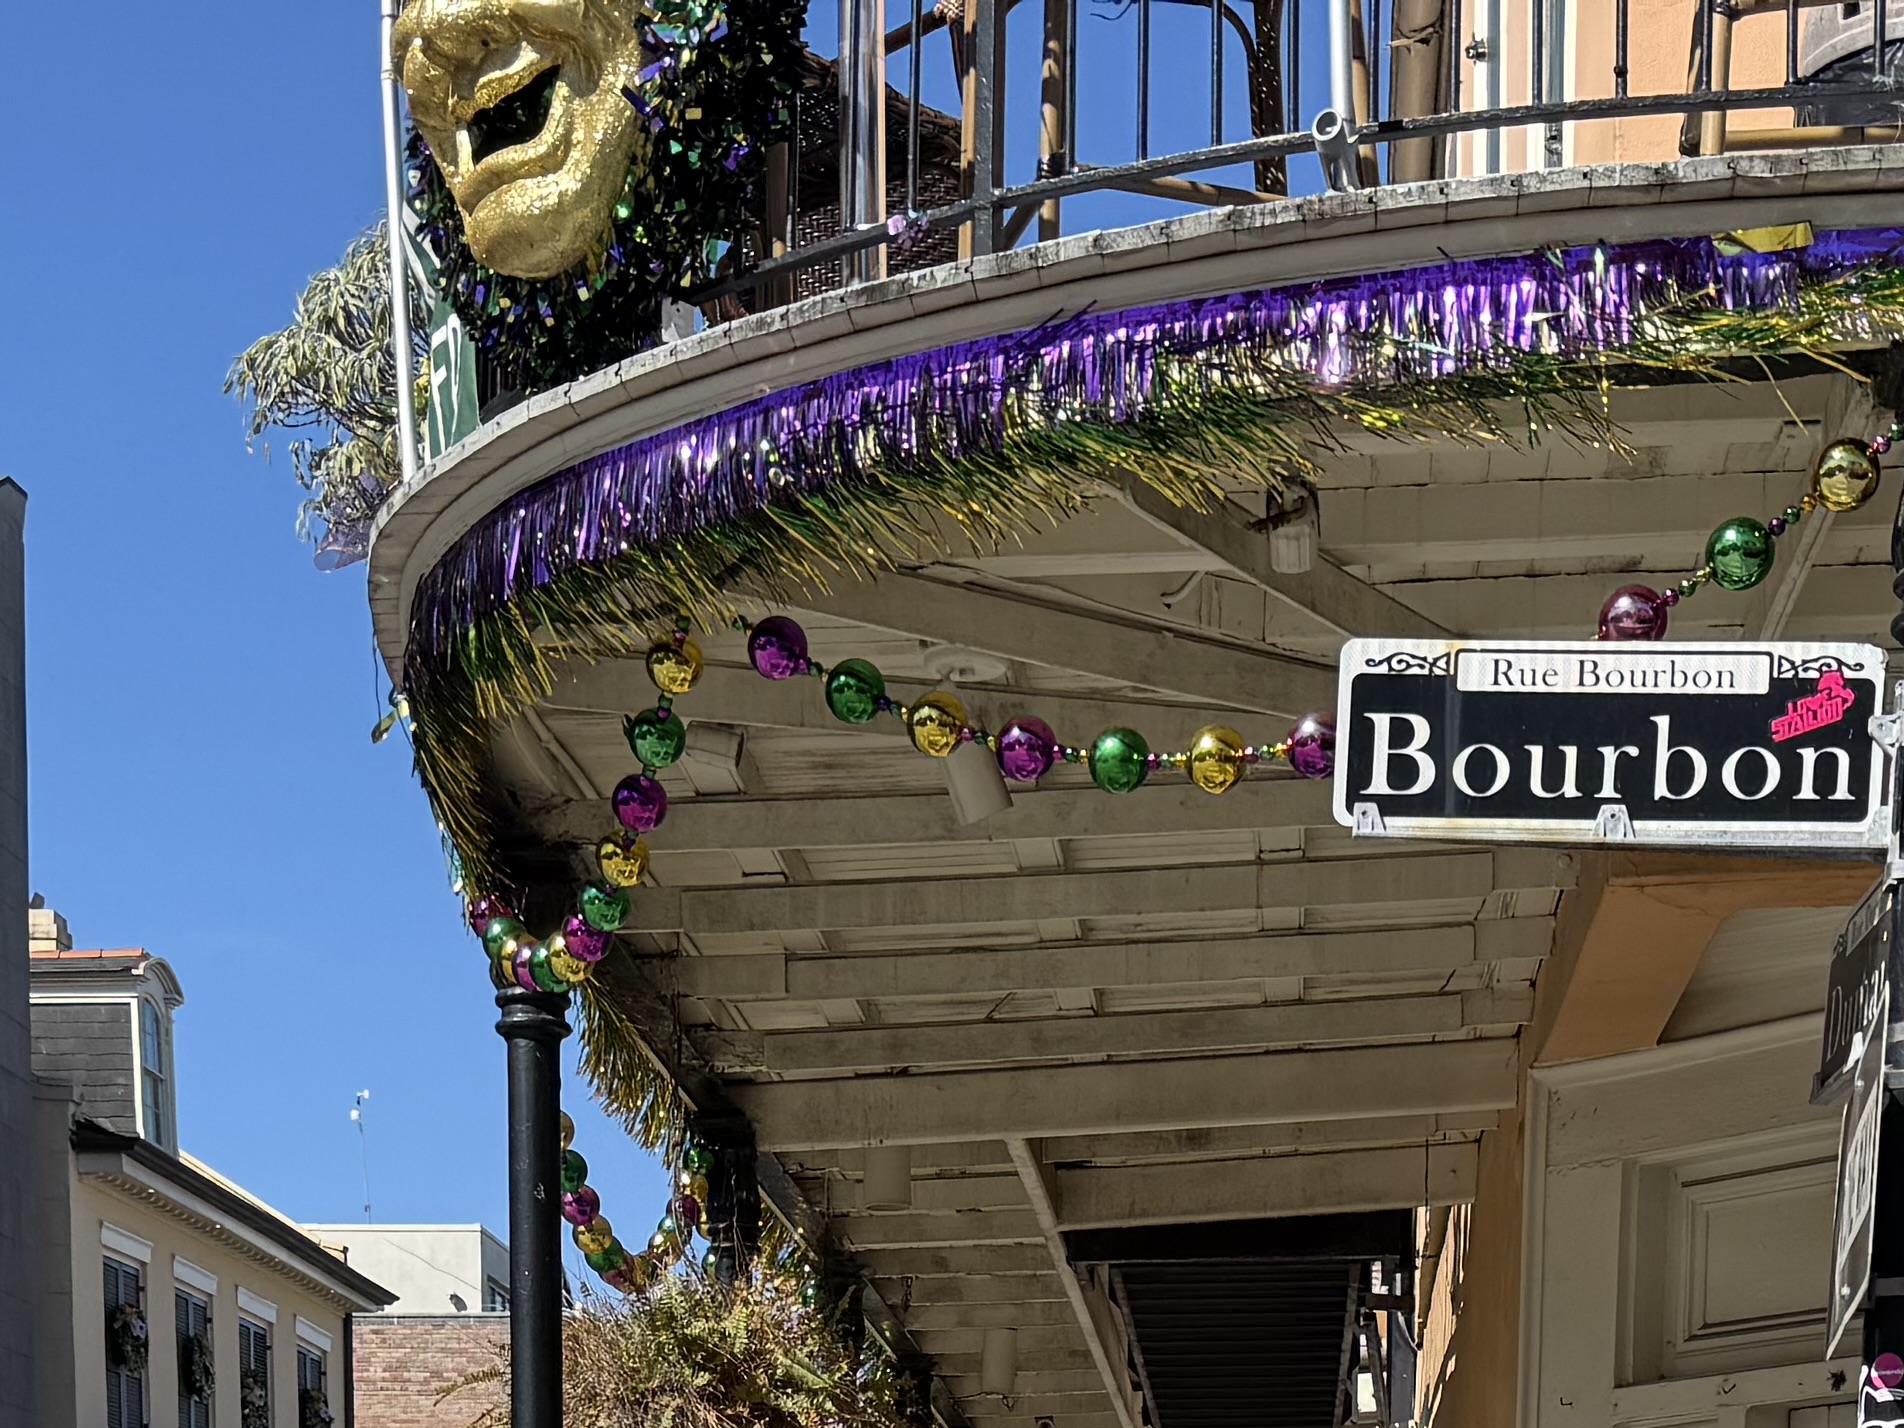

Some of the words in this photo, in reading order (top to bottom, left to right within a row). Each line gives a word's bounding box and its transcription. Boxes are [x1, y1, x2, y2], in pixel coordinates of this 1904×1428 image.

[1491, 658, 1560, 690] Rue
[1577, 657, 1737, 690] Bourbon
[1360, 711, 1856, 803] Bourbon
